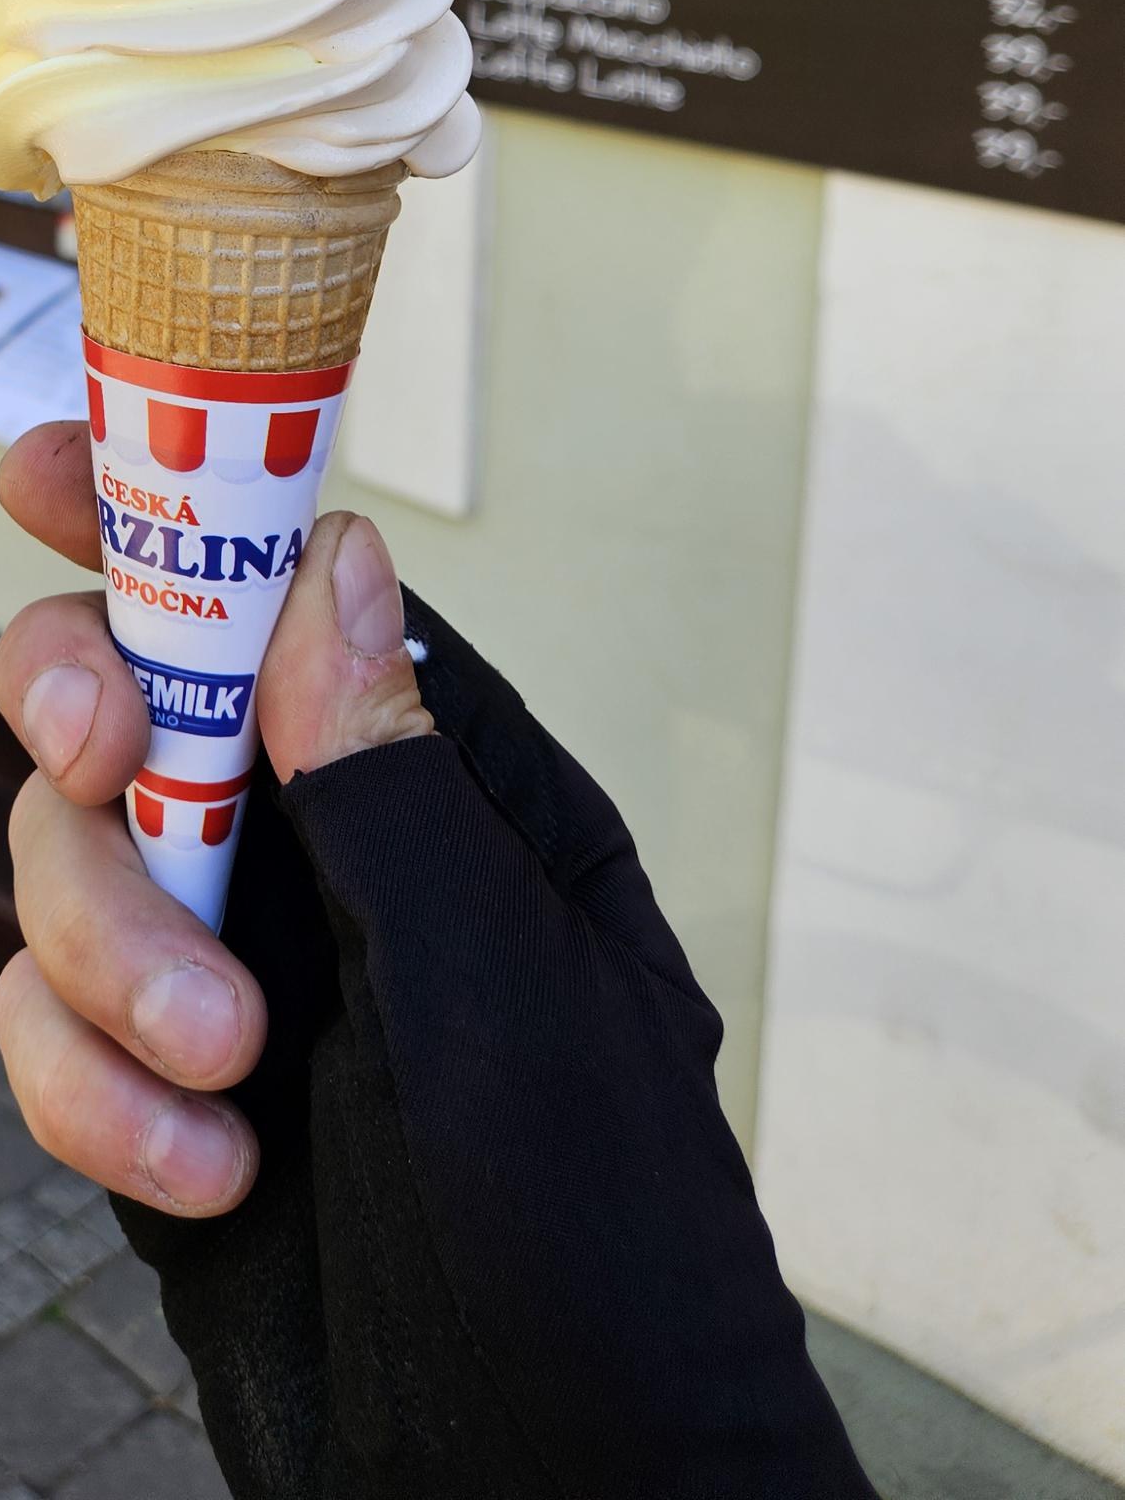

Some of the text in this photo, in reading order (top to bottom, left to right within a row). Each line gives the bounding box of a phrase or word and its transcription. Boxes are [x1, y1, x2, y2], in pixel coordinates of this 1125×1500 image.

[102, 463, 200, 526] ČESKÁ
[111, 566, 229, 620] OPOČNA
[127, 661, 244, 719] EMILK
